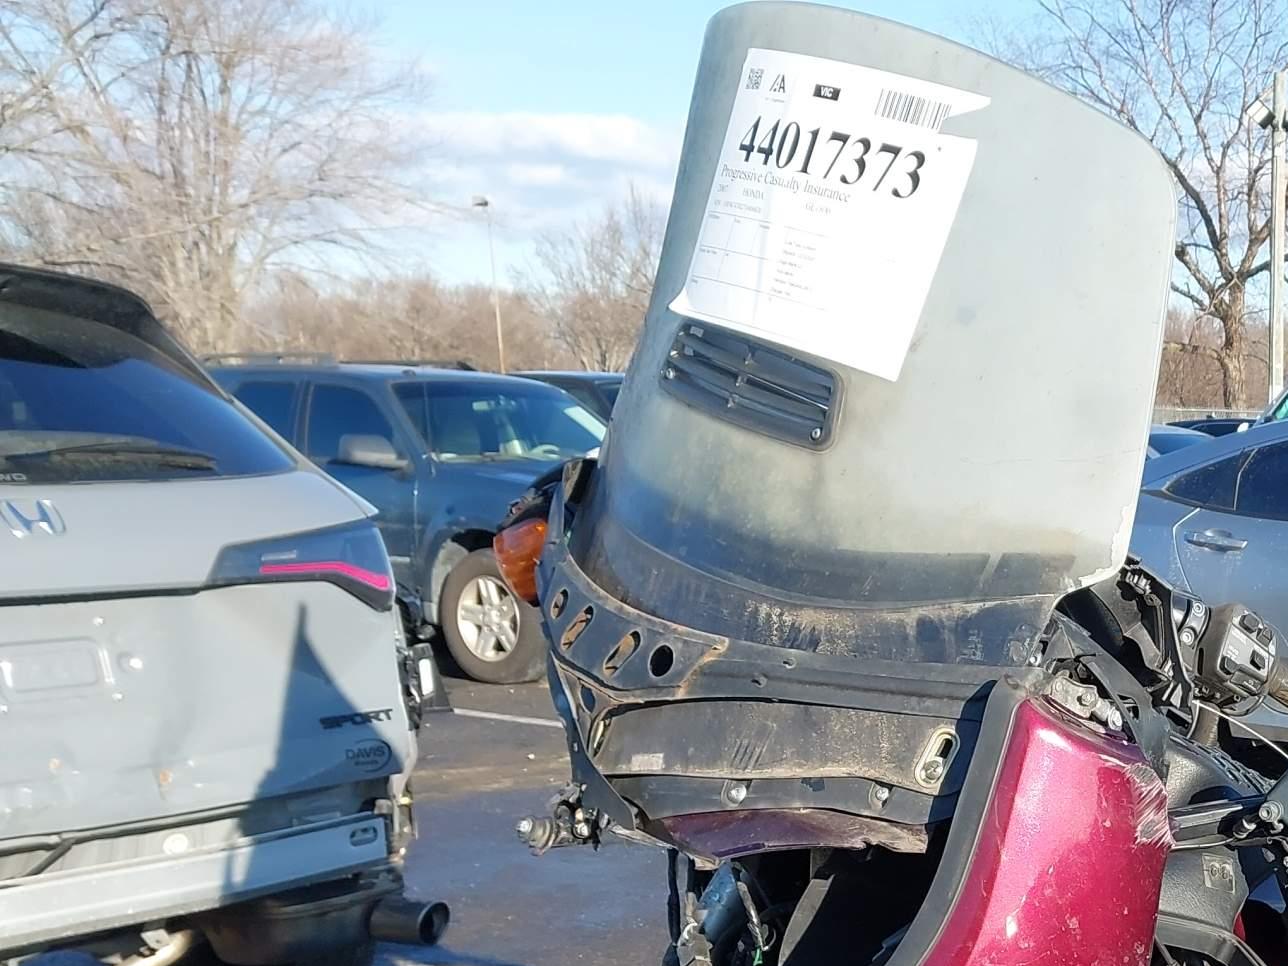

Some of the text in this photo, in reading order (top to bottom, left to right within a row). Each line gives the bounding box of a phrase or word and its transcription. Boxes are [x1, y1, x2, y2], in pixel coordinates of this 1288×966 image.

[820, 86, 835, 98] VIC
[738, 115, 926, 199] 44017373
[720, 163, 852, 203] Progressive Casualty Insurance
[319, 708, 393, 729] SPORT
[345, 746, 385, 760] DAVIS
